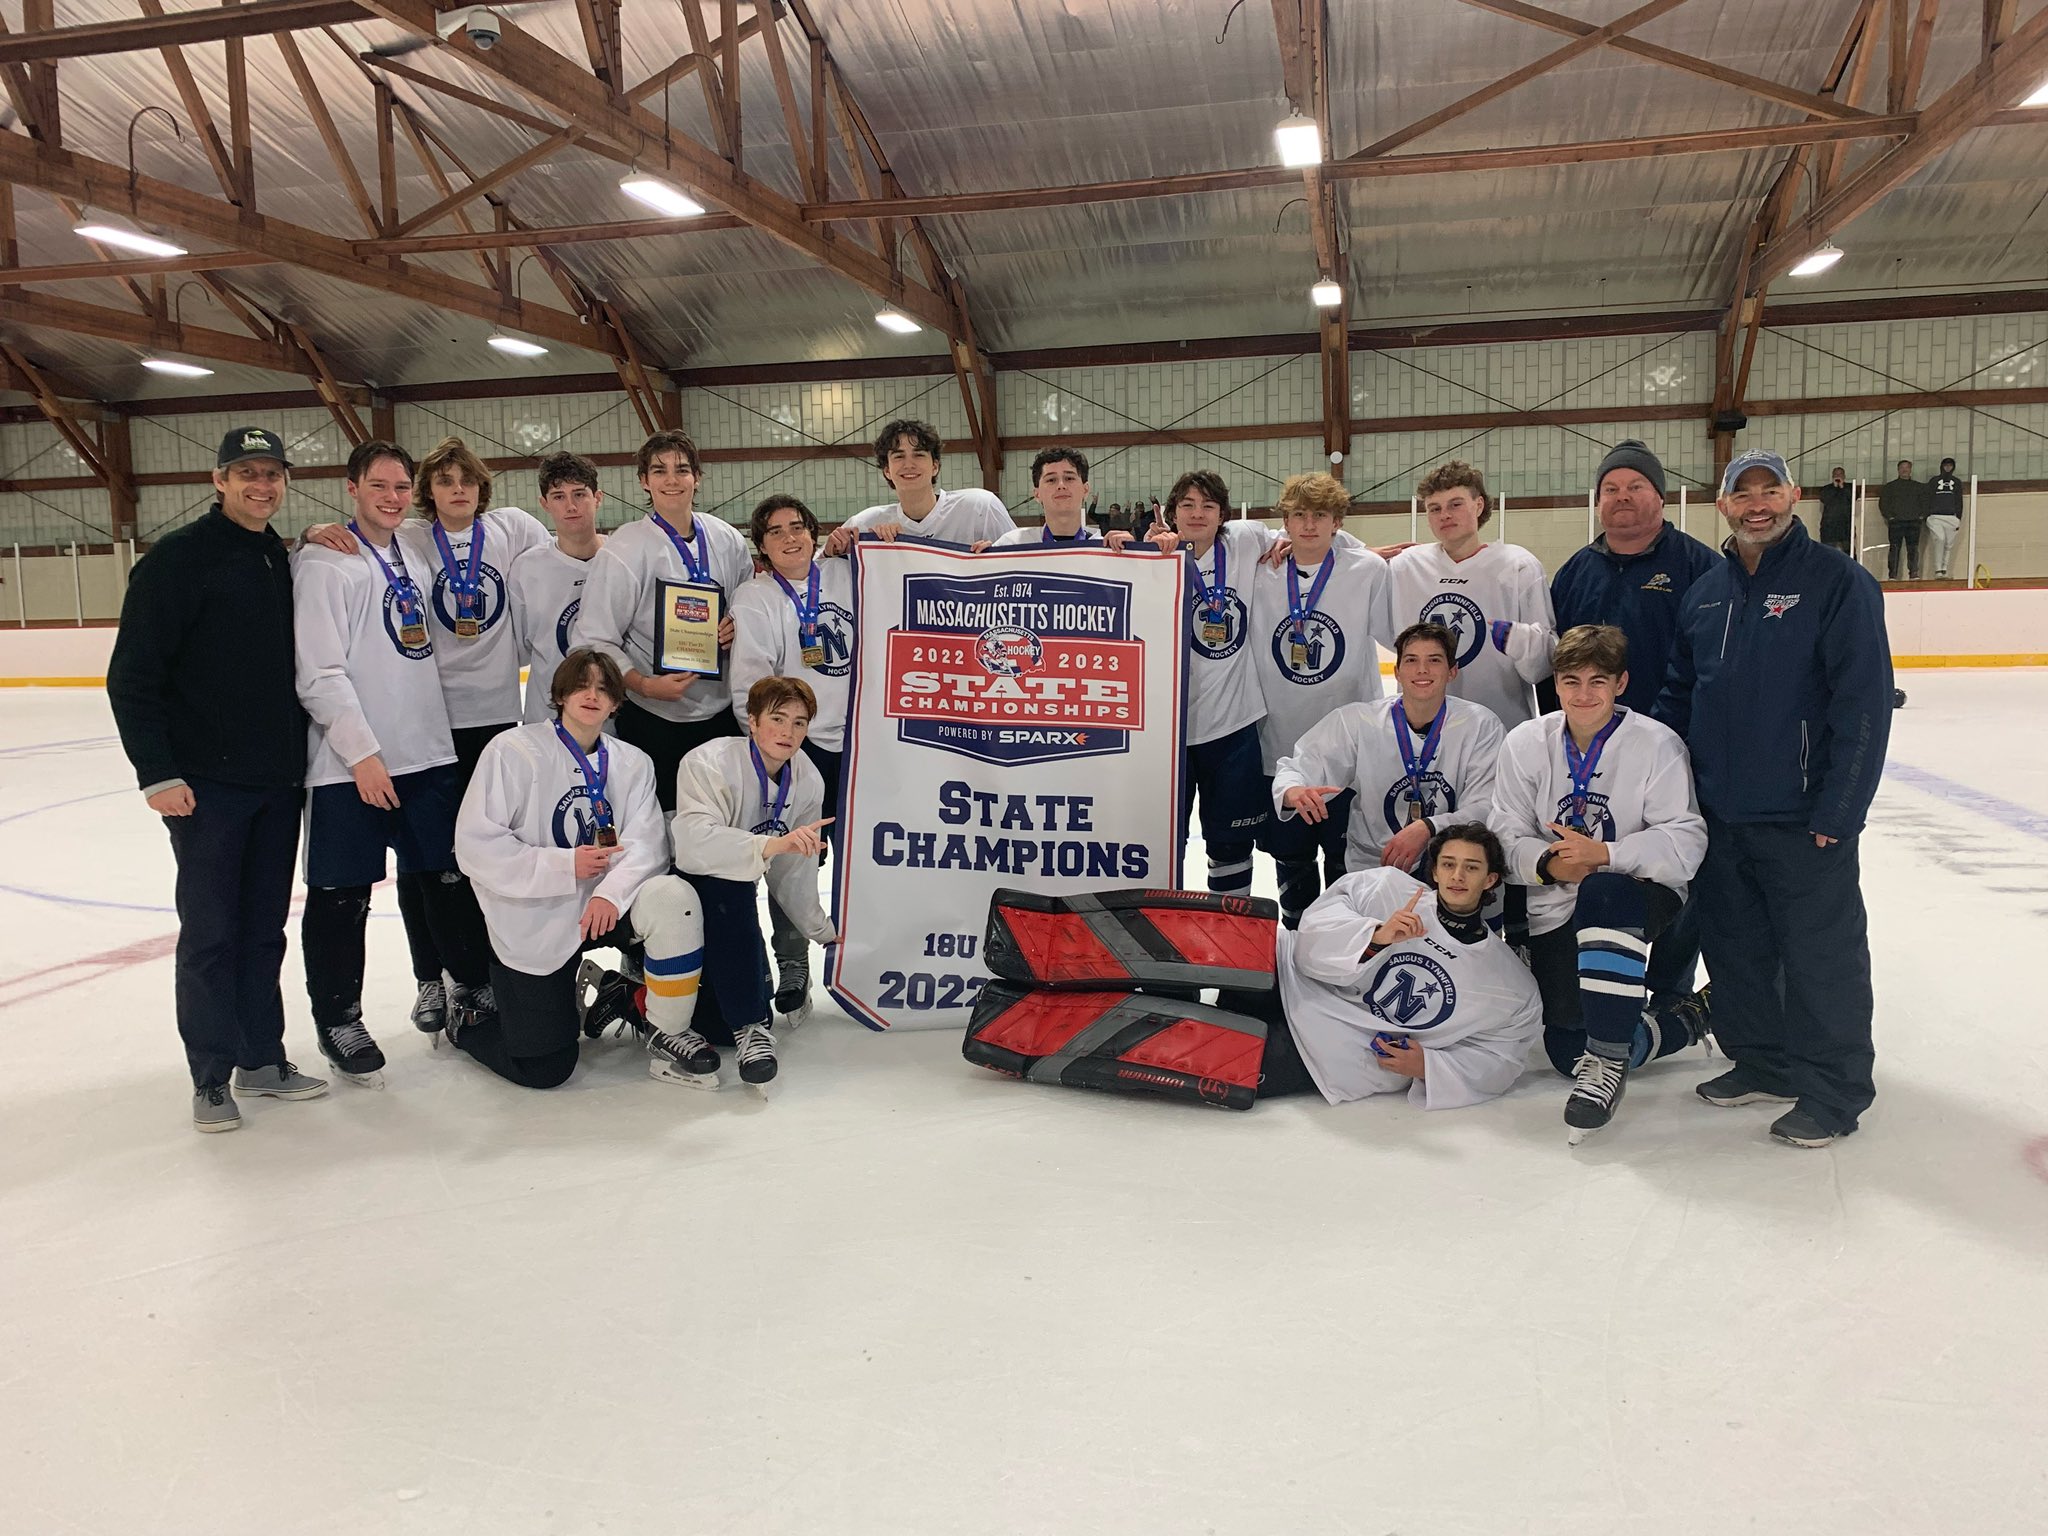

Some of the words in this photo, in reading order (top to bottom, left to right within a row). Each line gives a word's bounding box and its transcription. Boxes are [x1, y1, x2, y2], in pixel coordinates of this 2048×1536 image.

[459, 561, 501, 582] LYFIELD
[993, 584, 1009, 598] Est.
[1012, 583, 1033, 598] 1974
[917, 600, 1048, 630] MASSACHUSETTS
[1053, 604, 1117, 633] HOCKEY
[1420, 595, 1444, 620] SAUGUS
[1445, 594, 1482, 621] LYNNFIELD
[983, 627, 1035, 641] MASSACHUSETTS
[913, 646, 964, 665] 2022
[1058, 653, 1119, 671] 2023
[1007, 645, 1041, 655] HOCKEY
[1209, 643, 1239, 659] HOCKEY
[901, 671, 1129, 703] STATE
[1291, 673, 1325, 684] HOCKEY
[899, 695, 1130, 720] CHAMPIONSHIPS
[938, 725, 977, 740] POWERED
[981, 729, 993, 741] BY
[999, 730, 1078, 745] SPARX
[938, 780, 1094, 832] STATE
[872, 821, 1150, 879] CHAMPIONS
[923, 932, 978, 959] 18U
[1424, 937, 1458, 960] CCM
[1389, 954, 1424, 967] SAUGUS
[1424, 960, 1454, 1005] LYNNFIELD
